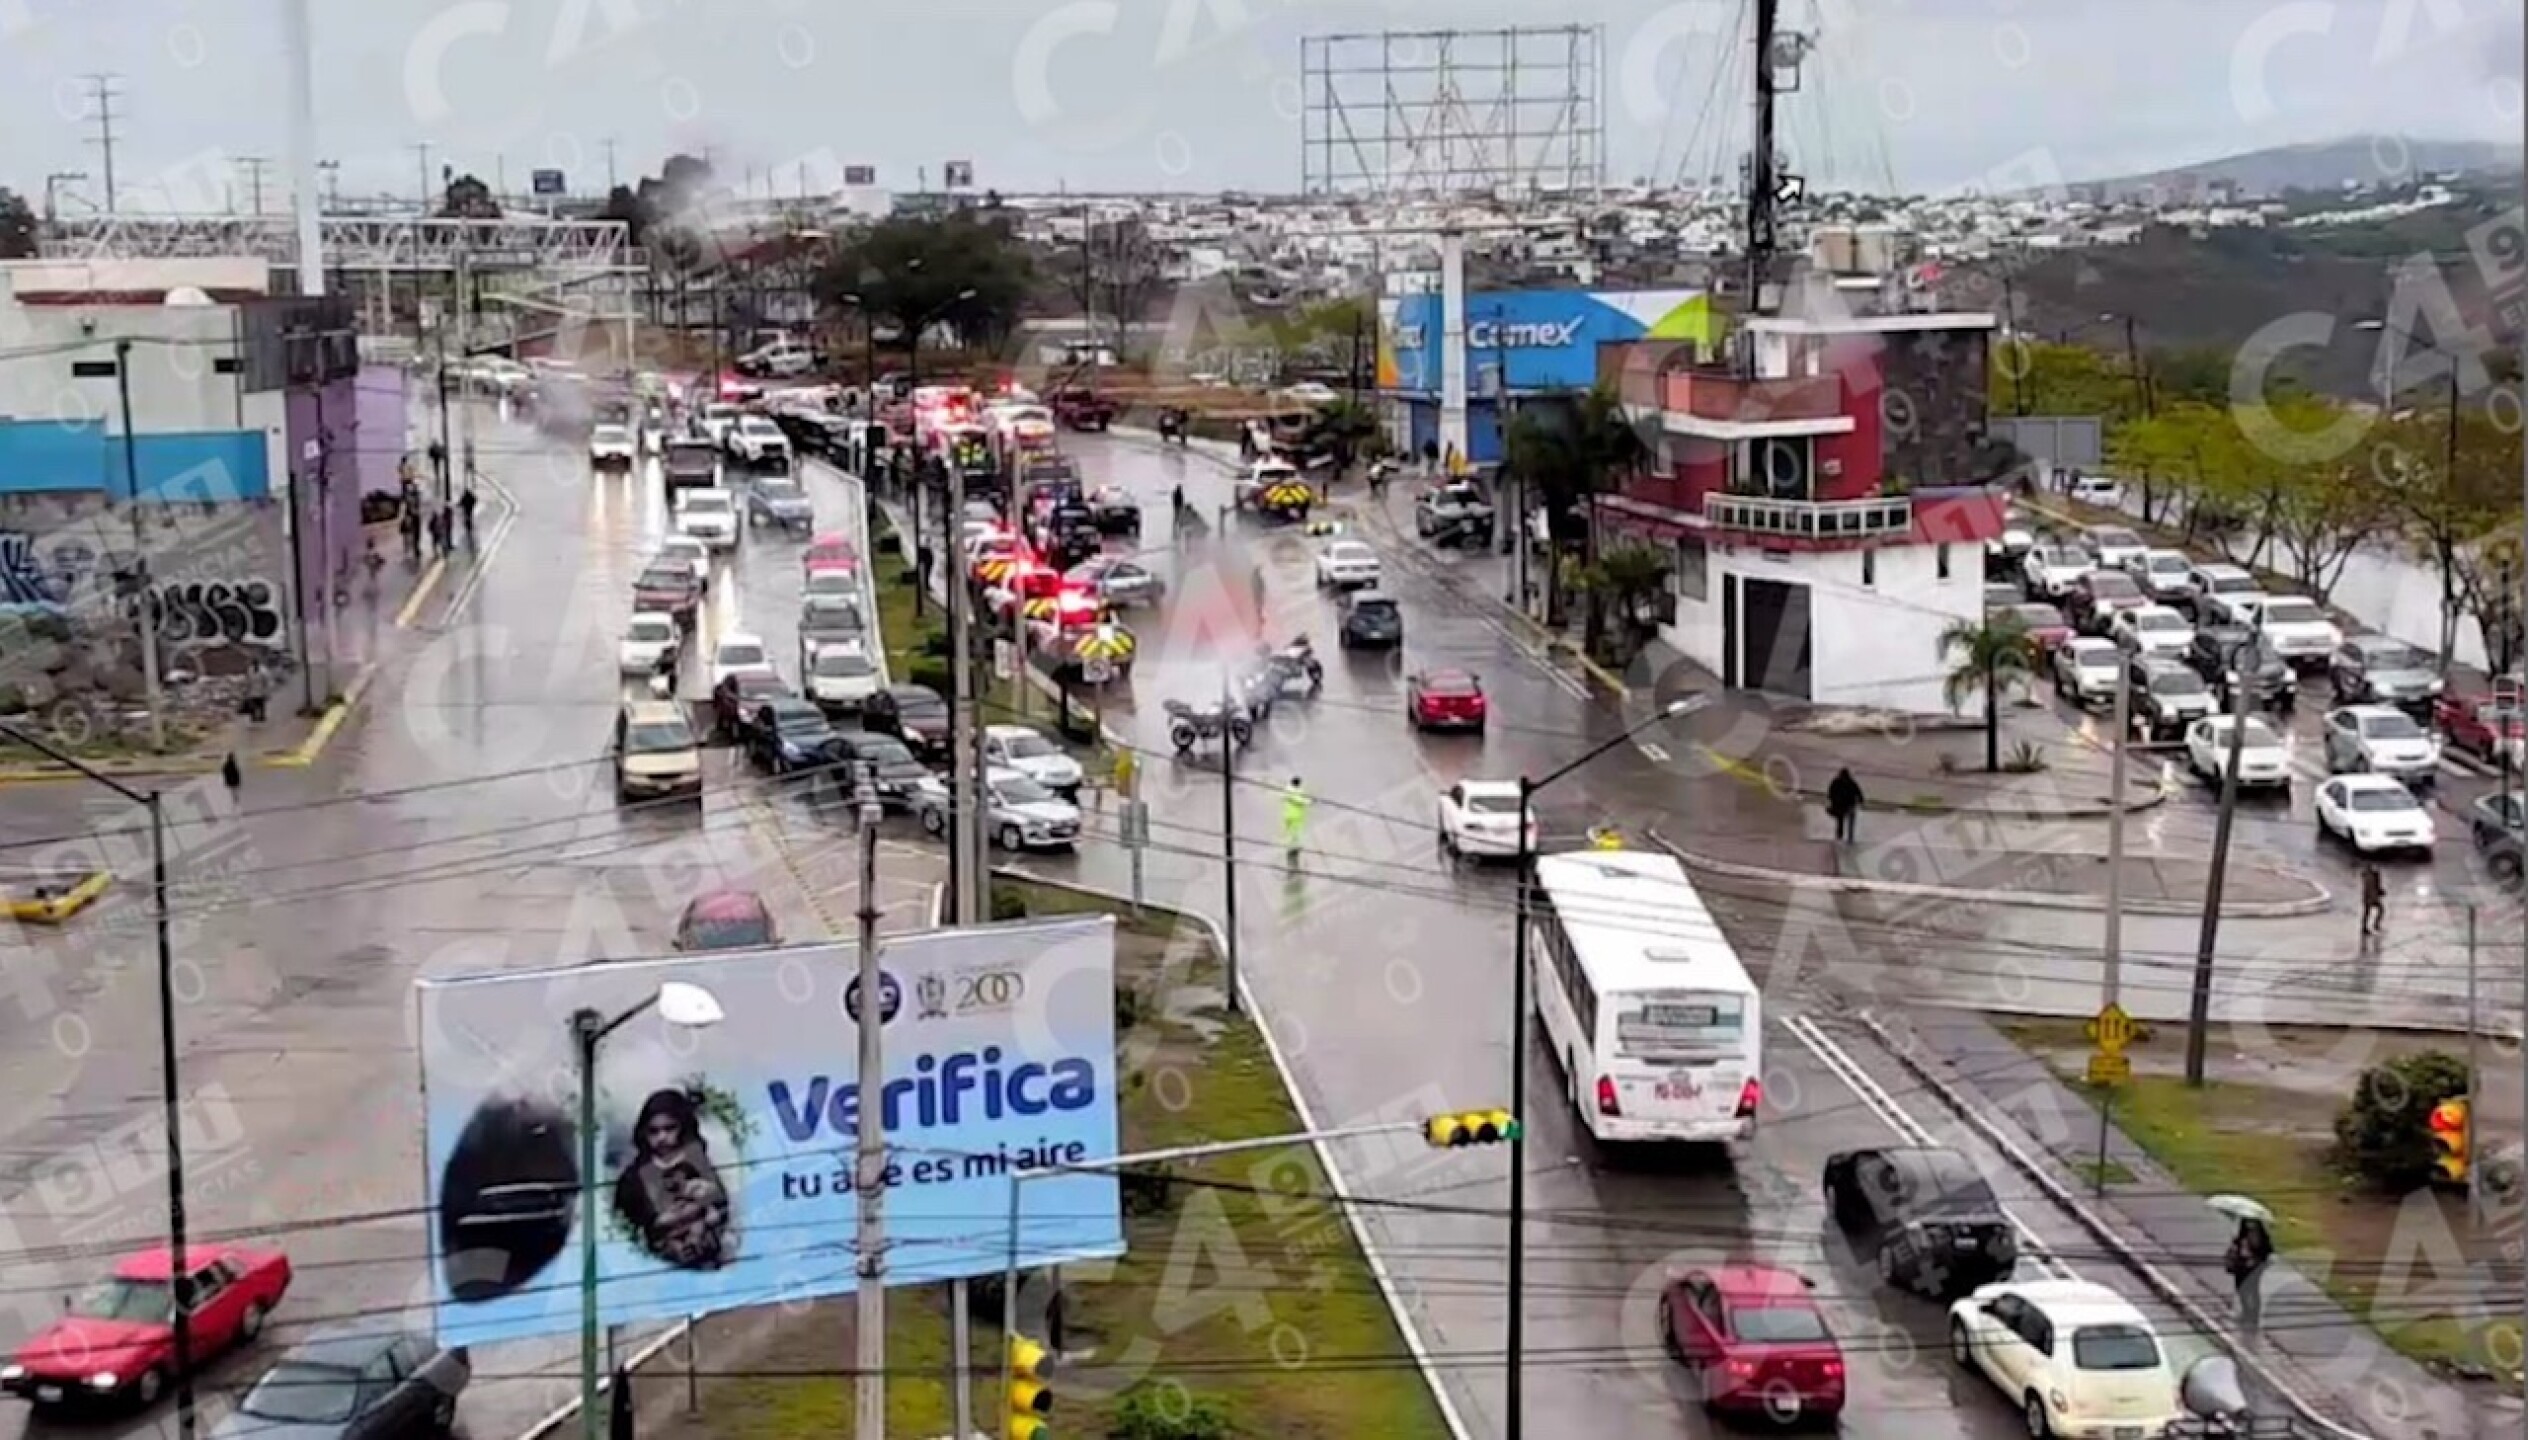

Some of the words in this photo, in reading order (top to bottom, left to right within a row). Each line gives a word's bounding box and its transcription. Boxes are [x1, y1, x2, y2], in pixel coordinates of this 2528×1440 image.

[766, 1045, 1095, 1143] Verifica
[782, 1171, 821, 1200] tu
[832, 1157, 903, 1194] ae
[913, 1160, 953, 1184] es
[963, 1142, 1008, 1180] mi
[1016, 1137, 1087, 1171] aire
